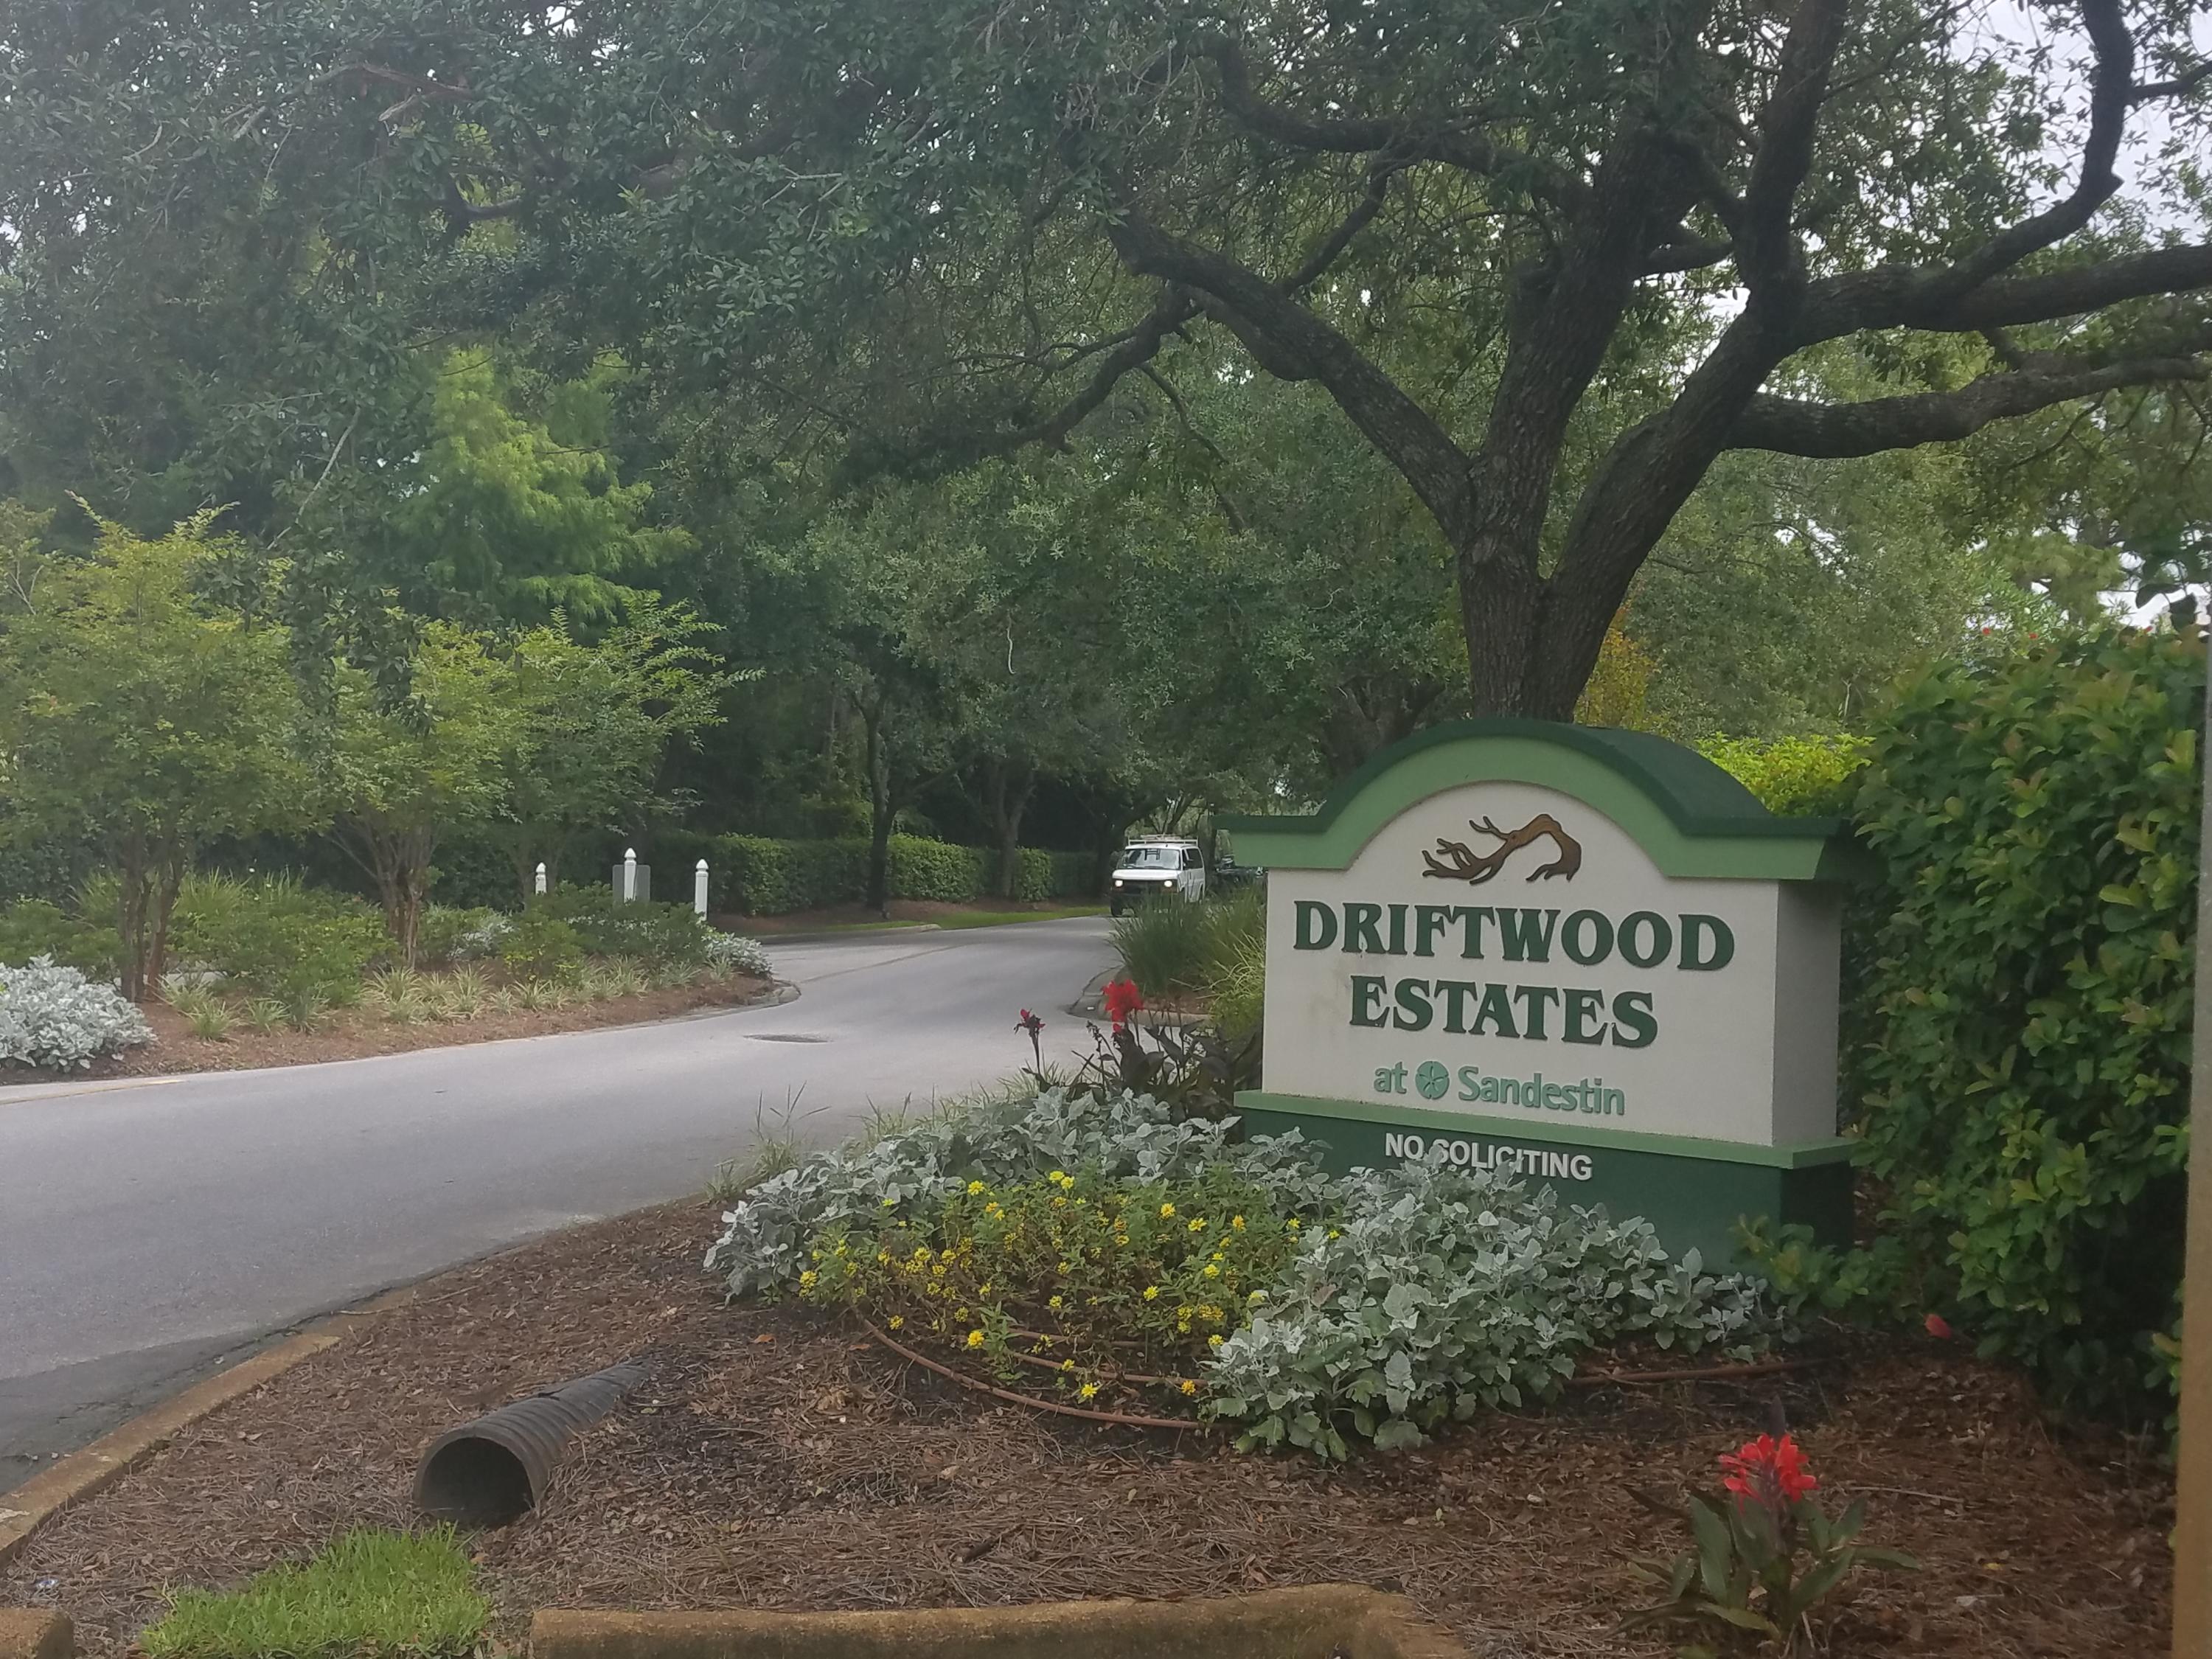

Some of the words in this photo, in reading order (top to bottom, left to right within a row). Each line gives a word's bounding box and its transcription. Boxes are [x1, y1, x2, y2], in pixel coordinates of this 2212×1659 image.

[1293, 900, 1735, 971] DRIFTWOOD
[1350, 975, 1658, 1048] ESTATES
[1373, 1061, 1408, 1094] at
[1458, 1066, 1626, 1116] Sandestin
[1385, 1133, 1425, 1161] NO
[1433, 1139, 1593, 1180] SOLICITING
